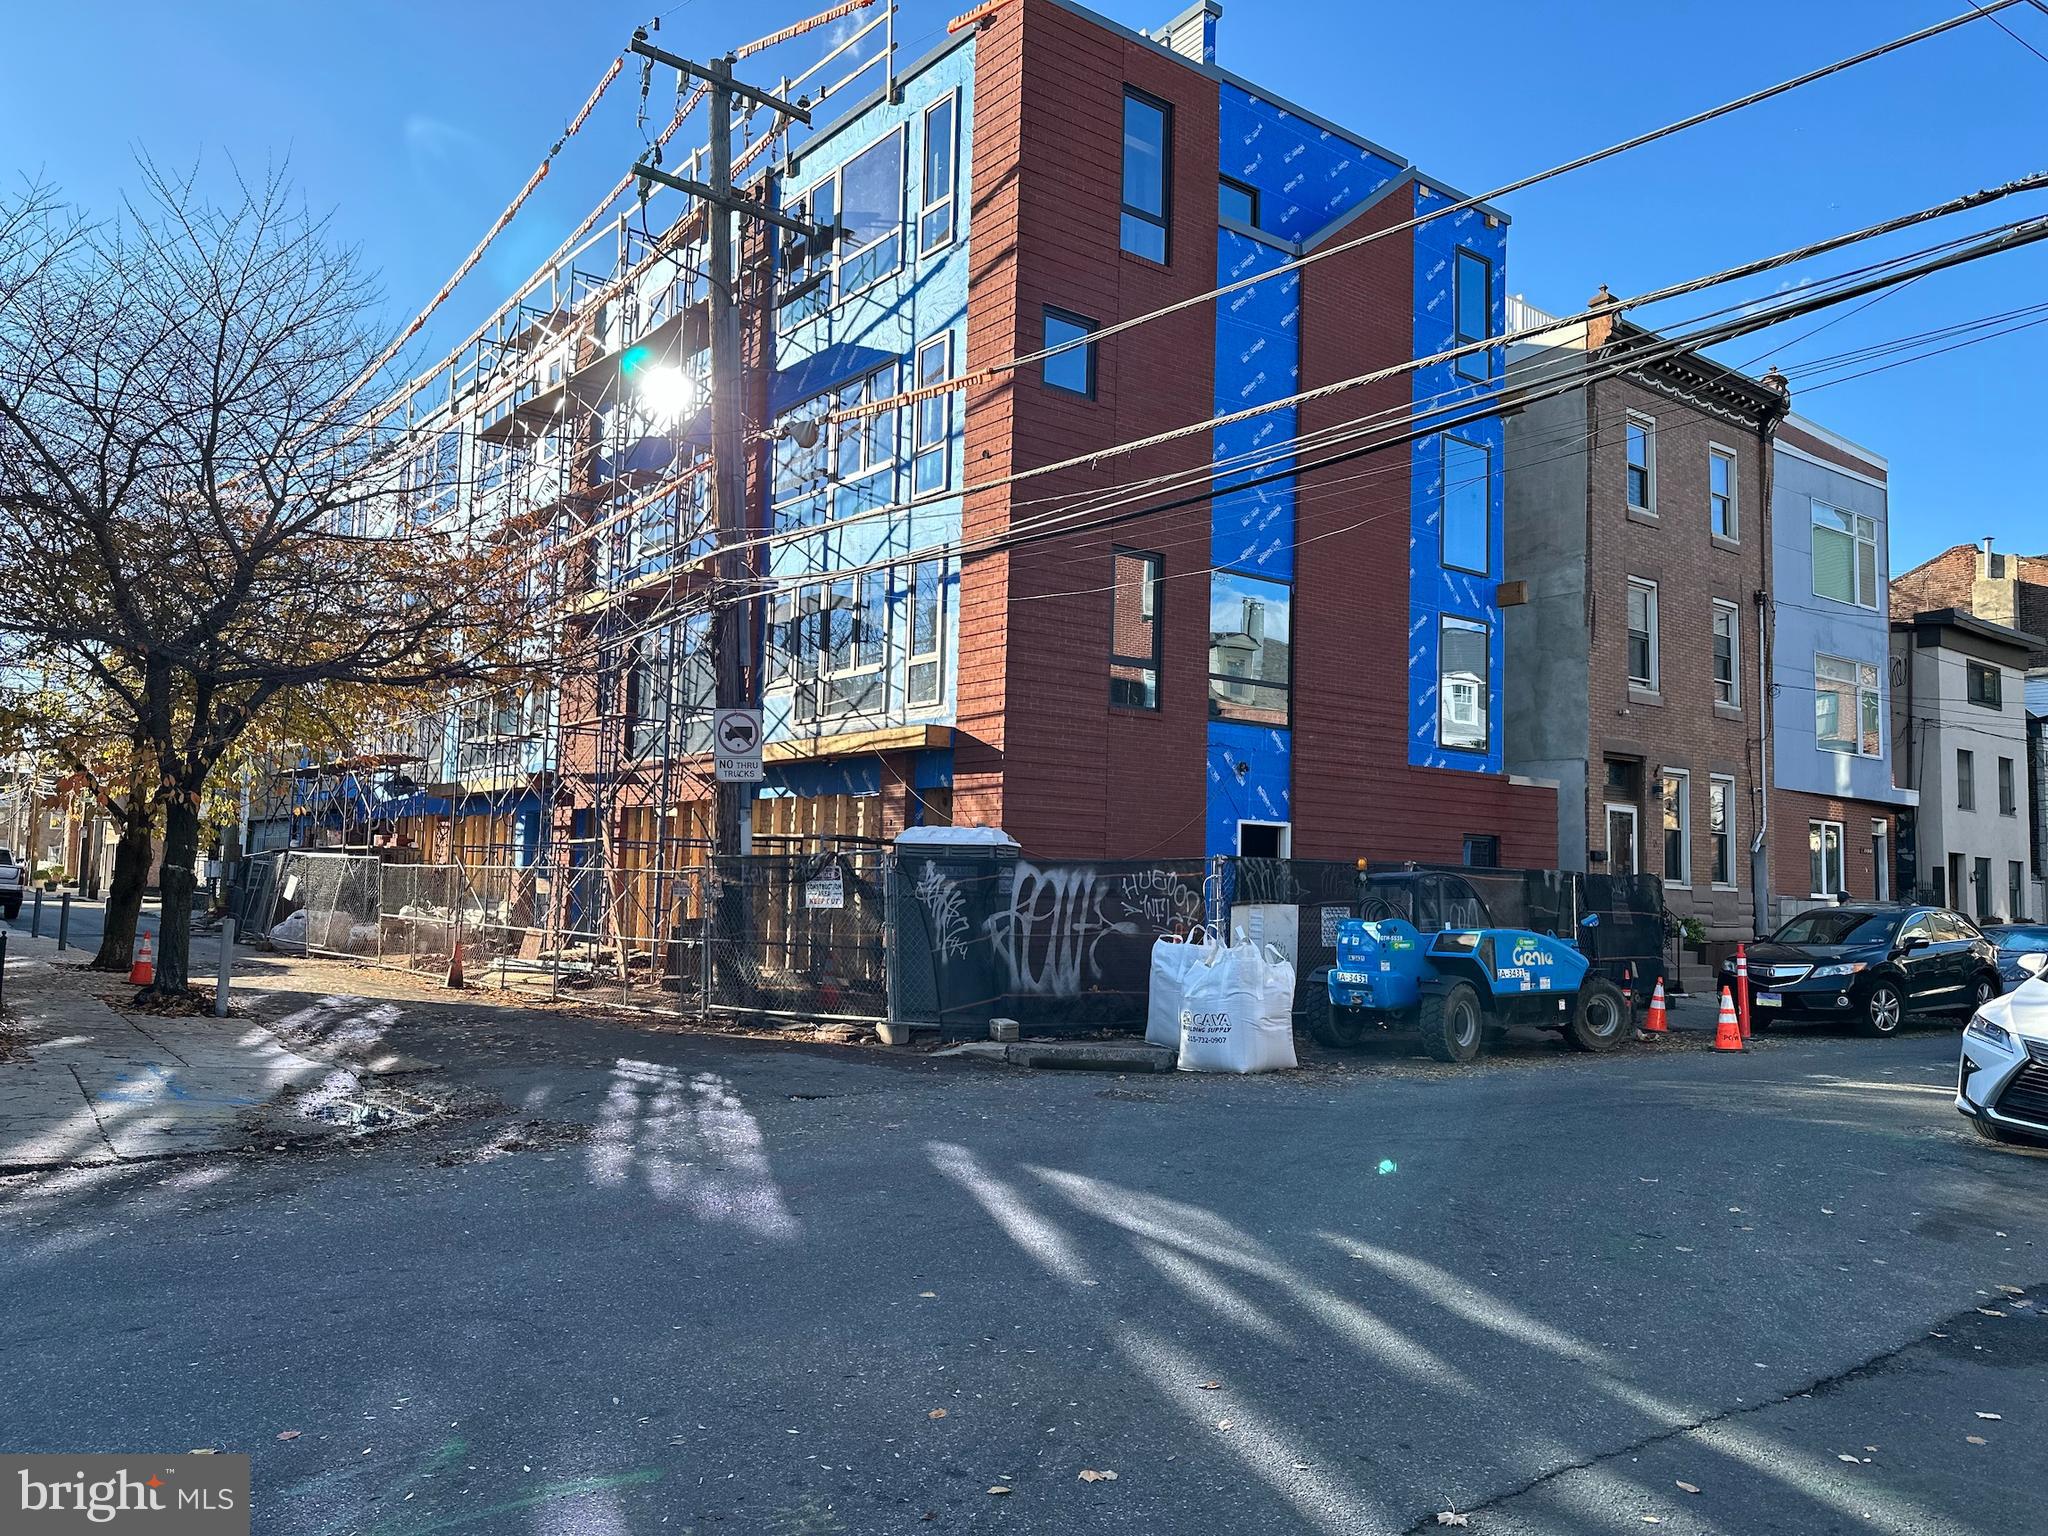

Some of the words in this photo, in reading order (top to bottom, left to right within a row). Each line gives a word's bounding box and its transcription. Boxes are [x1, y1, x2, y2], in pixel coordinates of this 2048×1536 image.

[719, 759, 734, 769] NO
[736, 761, 759, 769] THRU
[723, 770, 755, 778] TRUCKS
[806, 883, 842, 891] CONSTRUCTION
[809, 897, 826, 905] KEEP
[827, 897, 841, 905] OUT
[1512, 945, 1554, 966] Genie
[1193, 1012, 1232, 1026] CAVA
